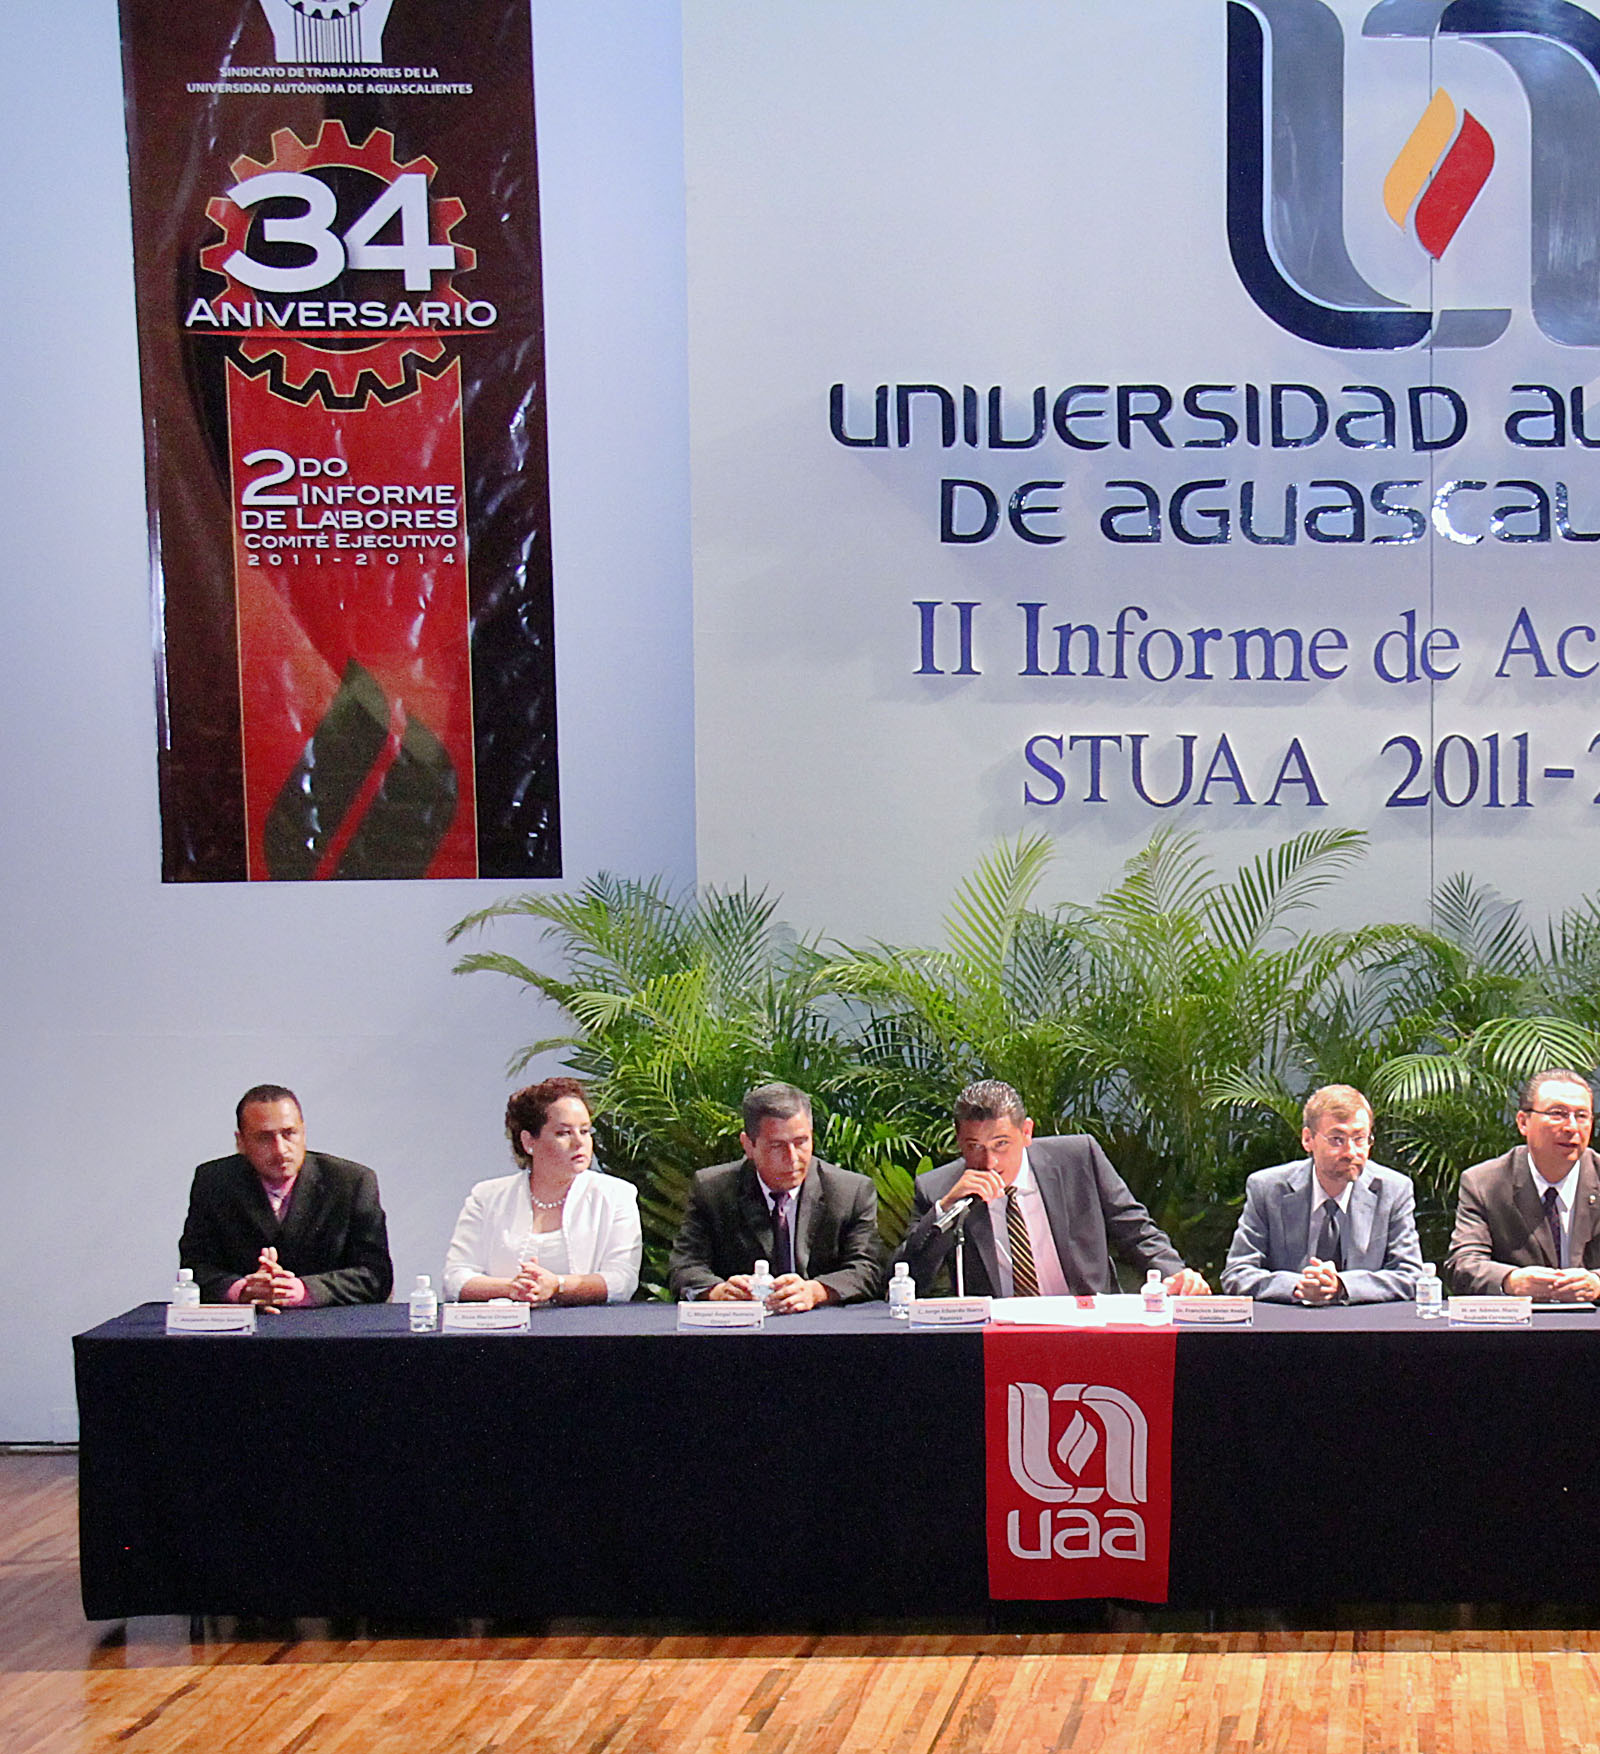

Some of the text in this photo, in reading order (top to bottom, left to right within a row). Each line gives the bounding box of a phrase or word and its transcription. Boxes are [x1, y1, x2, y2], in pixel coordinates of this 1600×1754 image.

[220, 67, 439, 78] SINDICATO DE TRABAJADORES DE LA
[186, 81, 473, 95] UNIVERSIDAD AUTÓNOMA DE AGUASCALIENTES
[222, 171, 457, 293] 34
[185, 298, 498, 328] ANIVERSARIO
[302, 483, 456, 505] INFORME
[241, 507, 458, 530] DE LABORES
[938, 479, 1067, 543] DE
[244, 532, 457, 549] COMITÉ EJECUTIVO
[911, 601, 985, 678] II
[1016, 601, 1349, 684] Informe
[1373, 609, 1463, 684] de
[1022, 733, 1329, 807] STUAA
